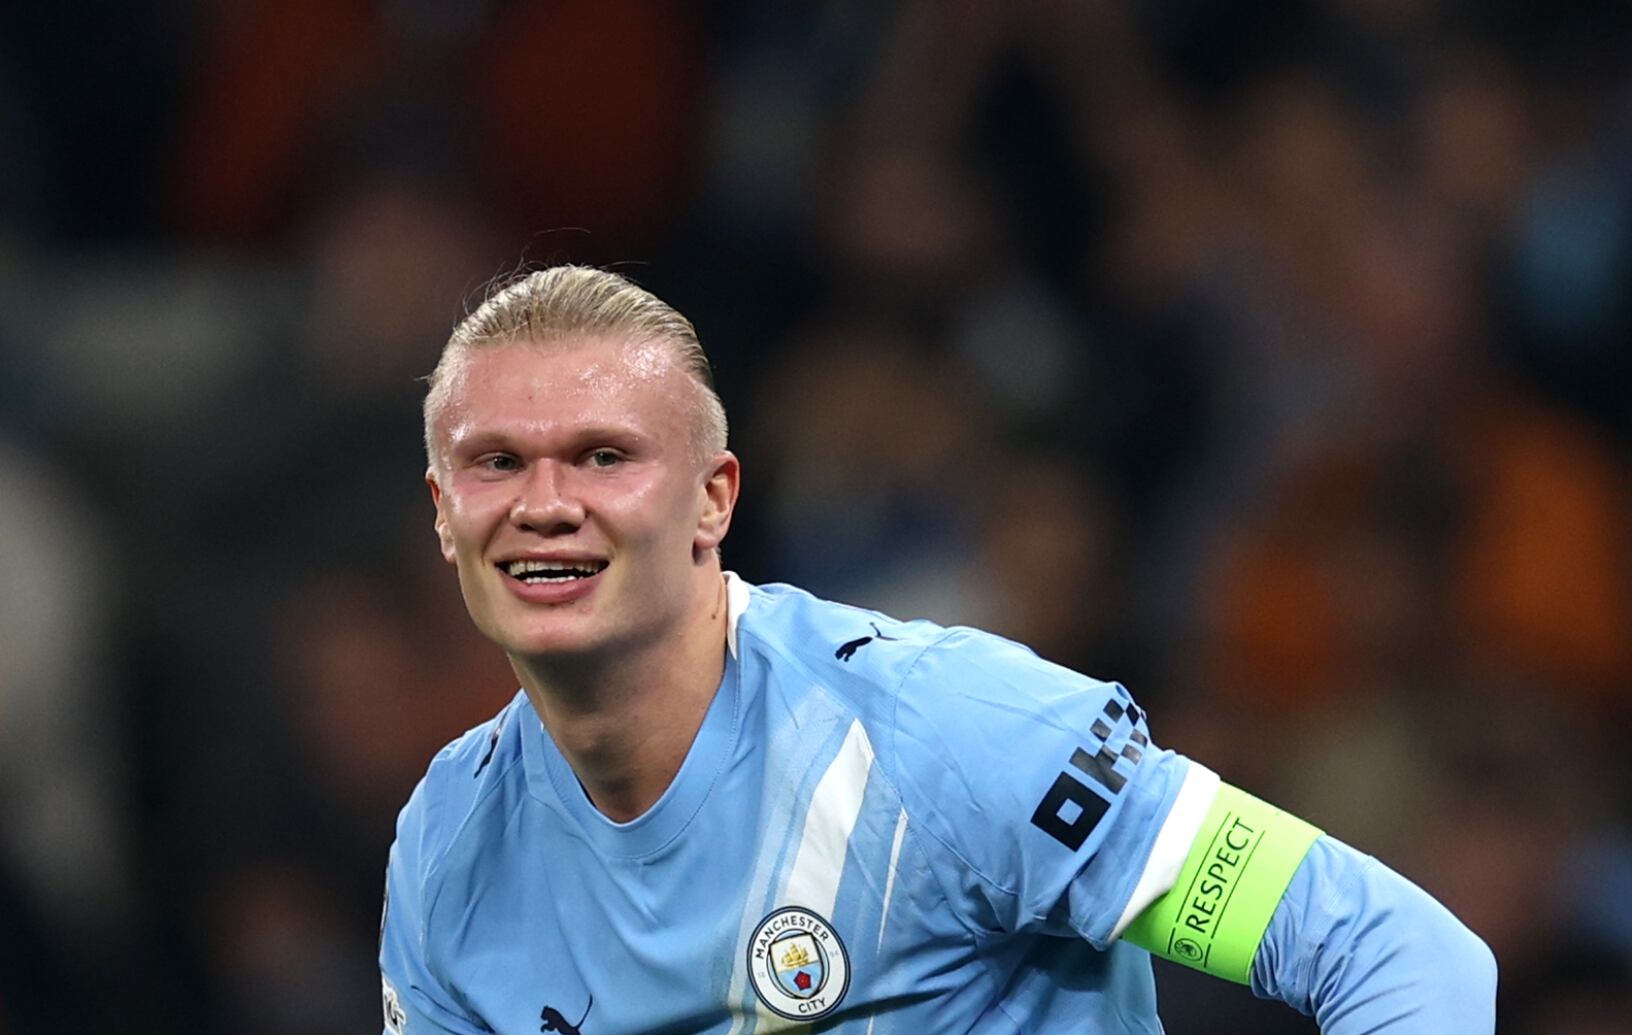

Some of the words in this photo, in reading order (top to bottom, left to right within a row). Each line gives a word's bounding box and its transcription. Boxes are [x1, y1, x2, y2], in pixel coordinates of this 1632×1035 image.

[1185, 816, 1255, 934] RESPECT
[755, 914, 829, 960] MANCHESTER
[798, 997, 826, 1014] CITY
